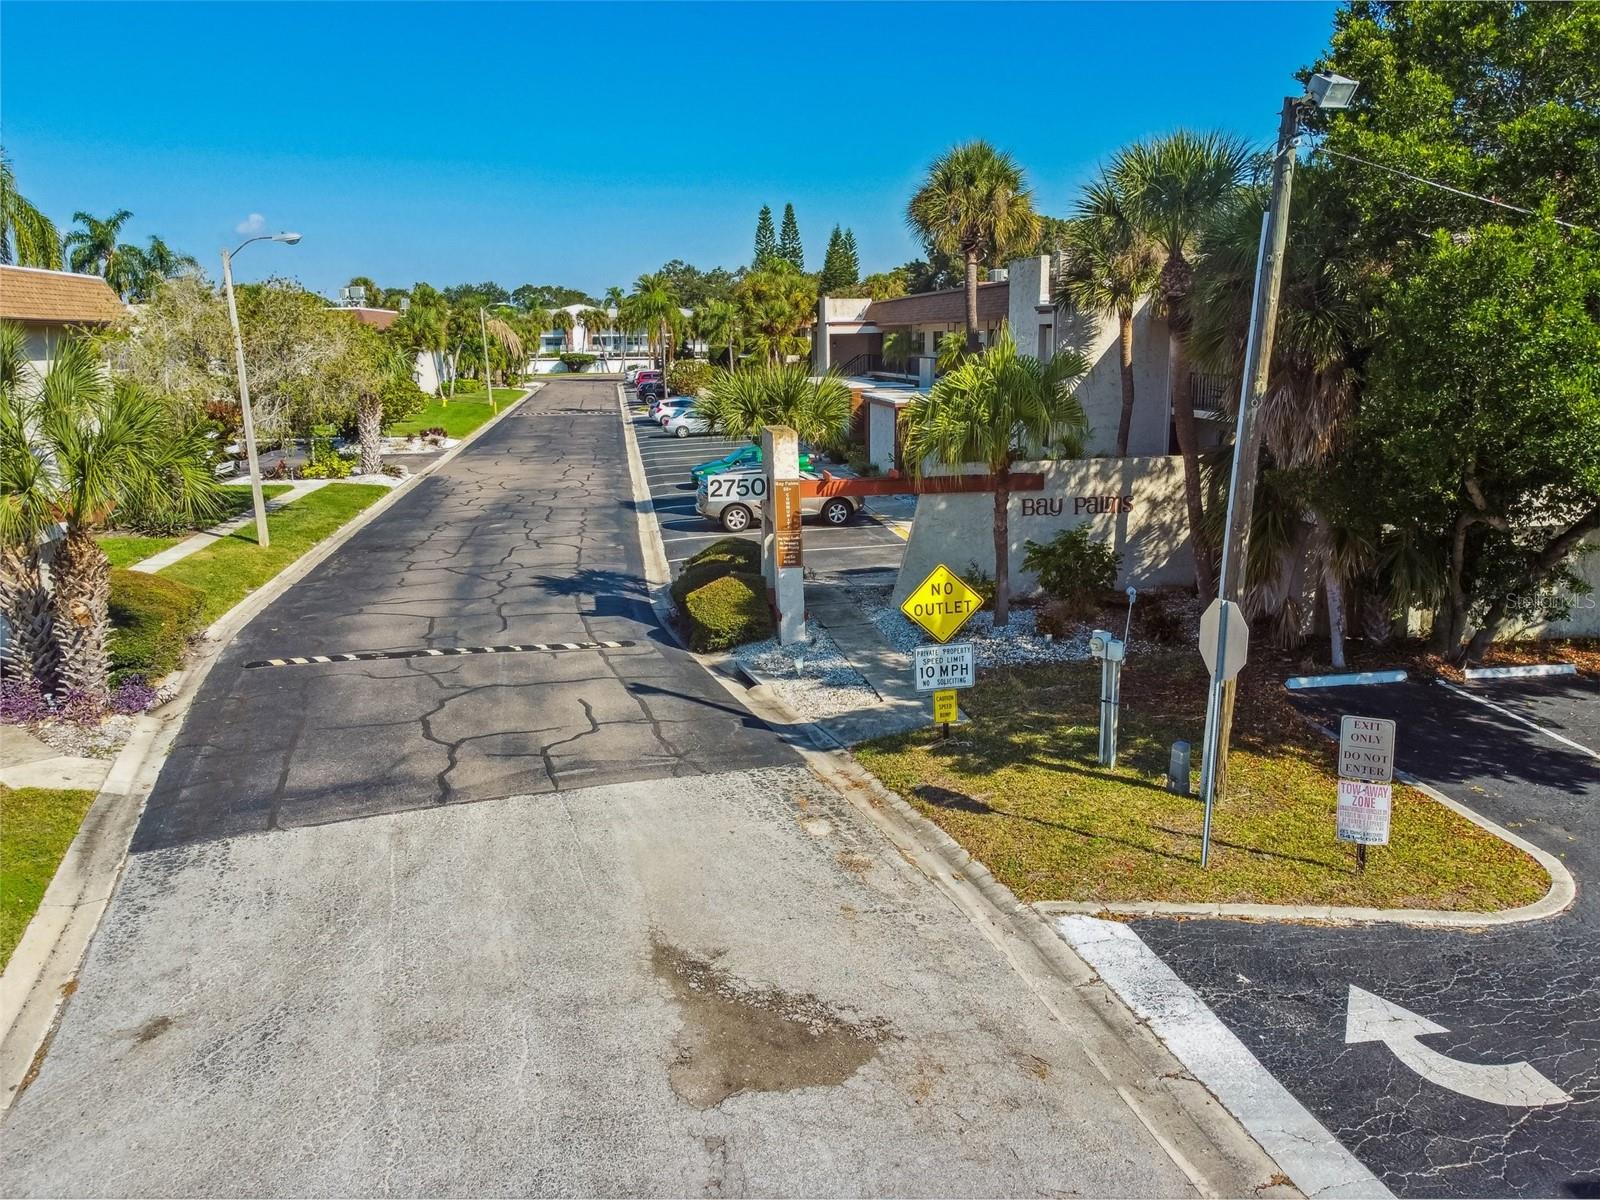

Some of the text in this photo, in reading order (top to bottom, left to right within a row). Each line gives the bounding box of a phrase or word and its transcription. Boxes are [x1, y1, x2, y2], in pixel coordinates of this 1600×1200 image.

[709, 477, 766, 498] 2750
[1021, 495, 1135, 517] Bay Palms
[931, 582, 953, 596] NO
[914, 599, 972, 617] OUTLET
[917, 646, 971, 657] PRIVATE PROPERTY
[922, 657, 944, 665] SPEED
[920, 663, 969, 679] 10 MPH
[937, 677, 967, 686] SOLICITING
[936, 694, 954, 702] CAUTION
[1354, 720, 1382, 731] EXIT
[1350, 733, 1384, 744] ONLY
[1344, 751, 1389, 764] DO NOT
[1345, 763, 1385, 777] ENTER
[1352, 795, 1376, 809] ZONE
